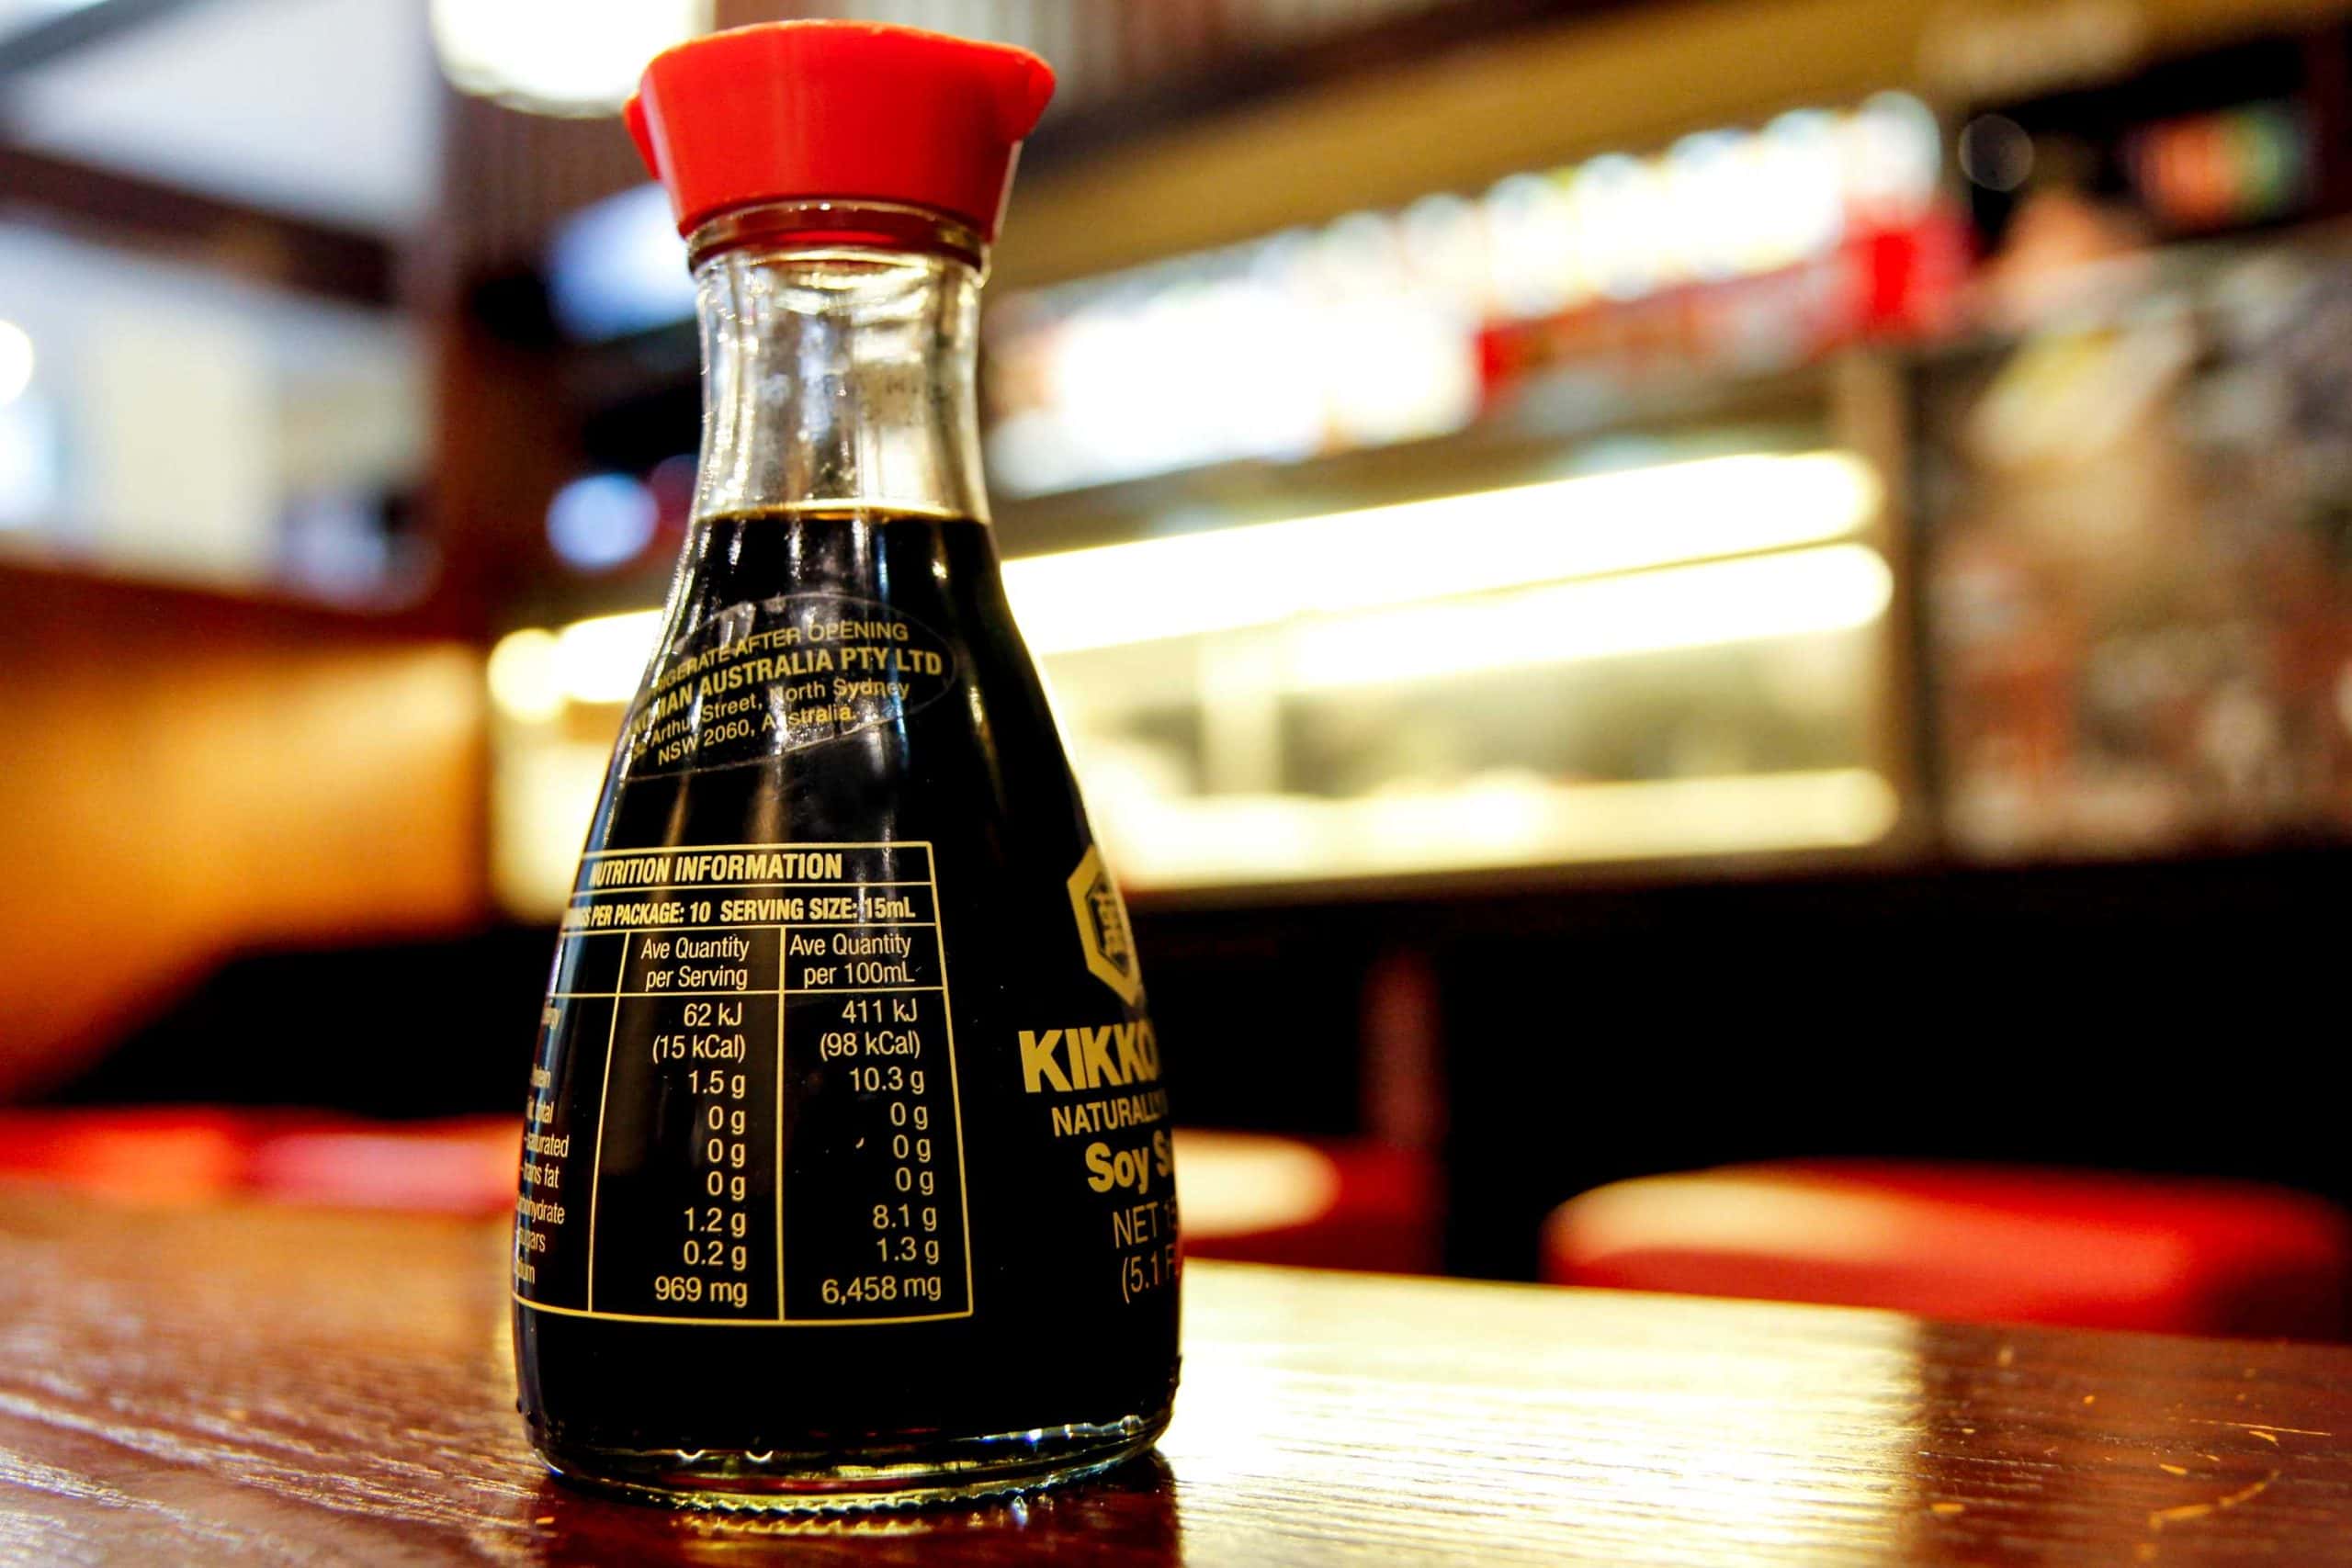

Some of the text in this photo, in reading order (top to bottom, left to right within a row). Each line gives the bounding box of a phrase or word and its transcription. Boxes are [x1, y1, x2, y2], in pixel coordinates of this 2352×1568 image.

[735, 627, 801, 657] AFTER
[808, 620, 909, 642] OPENING
[700, 648, 834, 696] AUSTRALIA
[840, 647, 888, 670] PTY
[895, 648, 943, 675] LTD
[650, 715, 695, 748] Arthu
[701, 692, 763, 724] Street,
[832, 677, 910, 702] Sydney
[658, 734, 699, 766] NSW
[703, 718, 755, 748] 2060,
[762, 704, 856, 732] Astralia.
[588, 852, 842, 887] NUTRITION INFORMATION
[591, 905, 614, 928] PER
[614, 901, 685, 927] PACKAGE:
[690, 900, 711, 923] 10
[720, 897, 804, 921] SERVING
[809, 897, 857, 920] SIZE:
[866, 897, 916, 919] 15mL
[640, 935, 750, 962] Ave Quantity
[790, 932, 911, 958] Ave Quantity
[645, 964, 748, 992] per Serving
[804, 962, 916, 989] per 100mL
[684, 1002, 742, 1027] 62 kJ
[842, 998, 919, 1023] 411 kJ
[652, 1033, 746, 1064] (15 kCal)
[820, 1030, 921, 1061] (98 kCal)
[689, 1069, 746, 1099] 1.5 g
[850, 1066, 925, 1093] 10.3 g
[708, 1106, 746, 1134] 0 g
[890, 1102, 929, 1131] 0 g
[708, 1139, 746, 1167] 0 g
[893, 1134, 932, 1163] 0 g
[543, 1163, 560, 1189] fat
[896, 1167, 934, 1195] 0 g
[1085, 1142, 1148, 1194] Soy
[707, 1172, 746, 1200] 0 g
[684, 1208, 746, 1236] 1.2 g
[873, 1204, 938, 1232] 8.1 g
[1113, 1201, 1159, 1249] NET
[683, 1241, 746, 1270] 0.2 g
[877, 1237, 940, 1265] 1.3 g
[655, 1277, 748, 1307] 969 mg
[821, 1273, 942, 1304] 6,458 mg
[1122, 1251, 1159, 1304] (5.1
